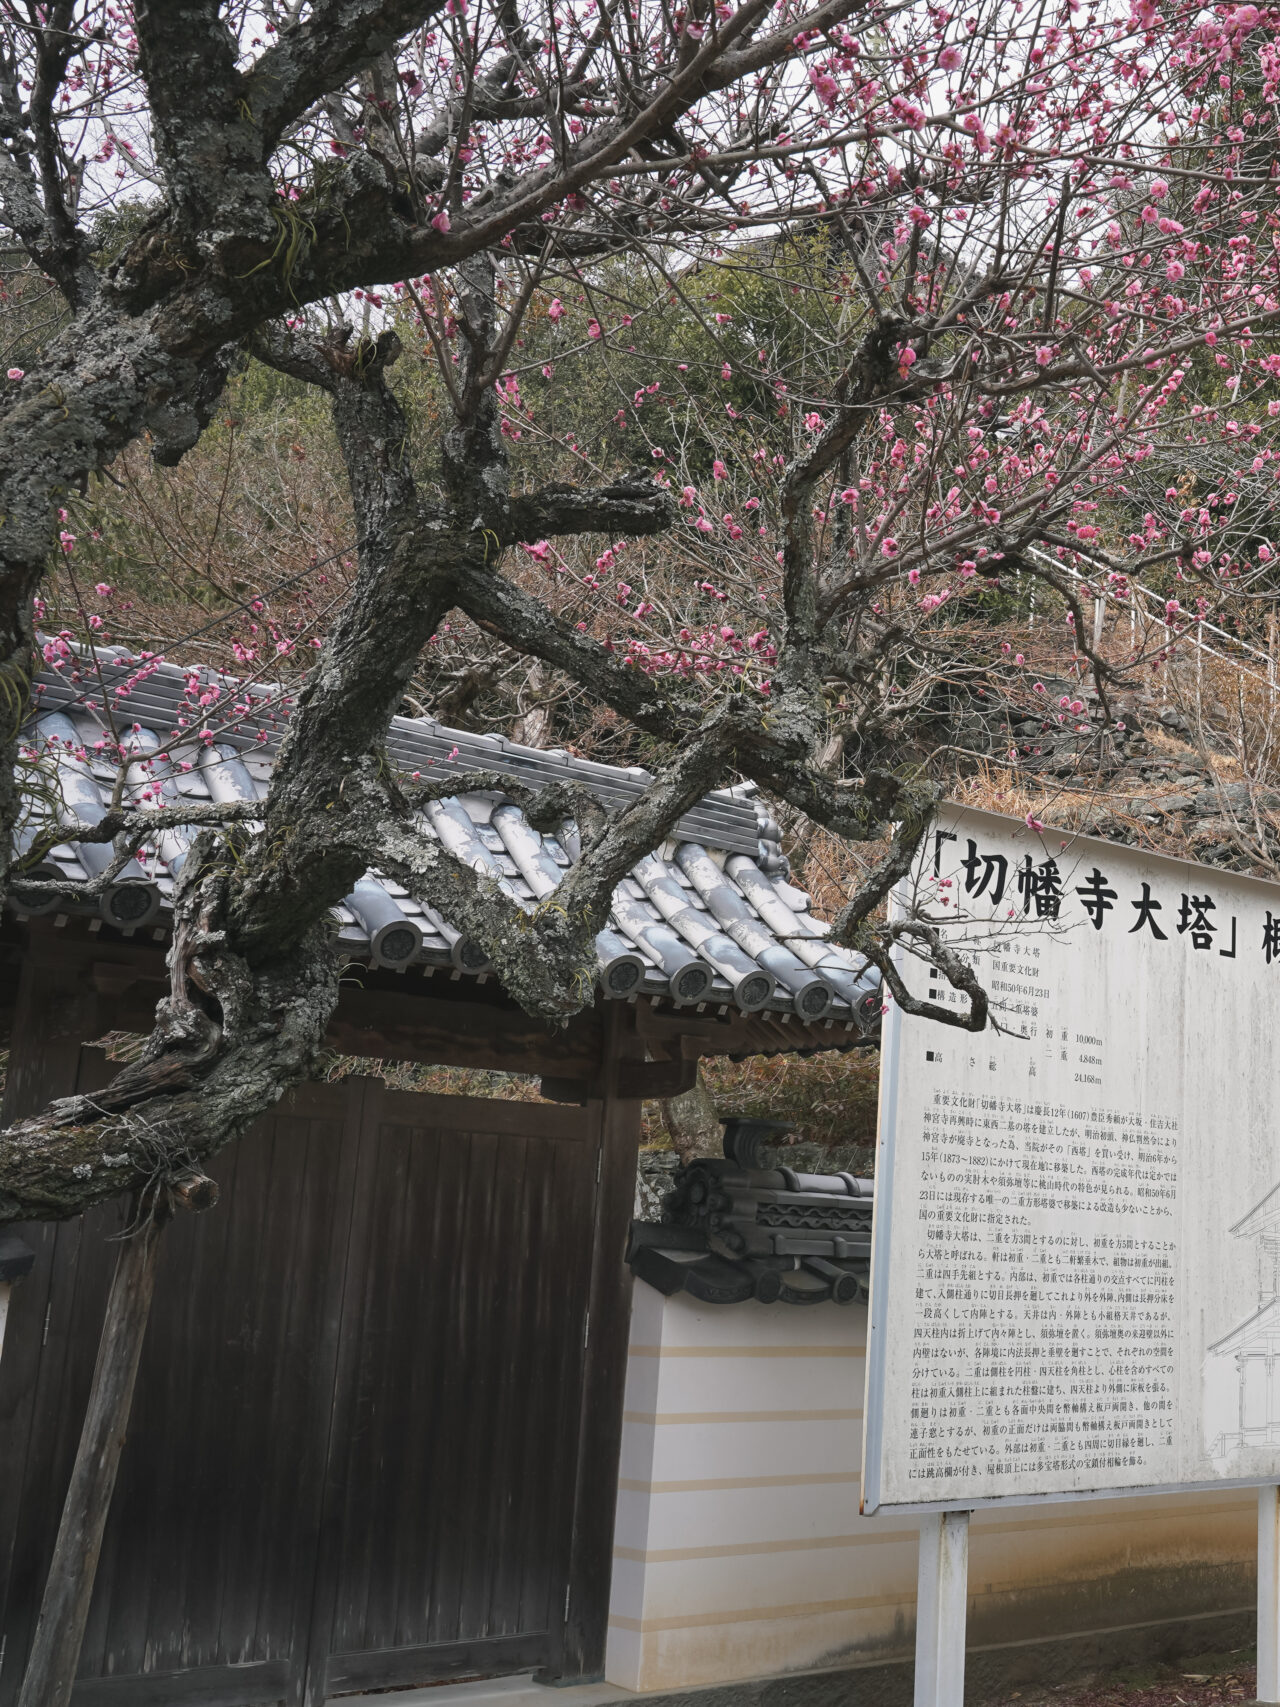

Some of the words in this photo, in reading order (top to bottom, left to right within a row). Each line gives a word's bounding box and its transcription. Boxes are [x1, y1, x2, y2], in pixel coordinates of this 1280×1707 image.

[992, 959, 1040, 977] 国重要文化財
[991, 980, 1050, 999] 昭和50年6月23日
